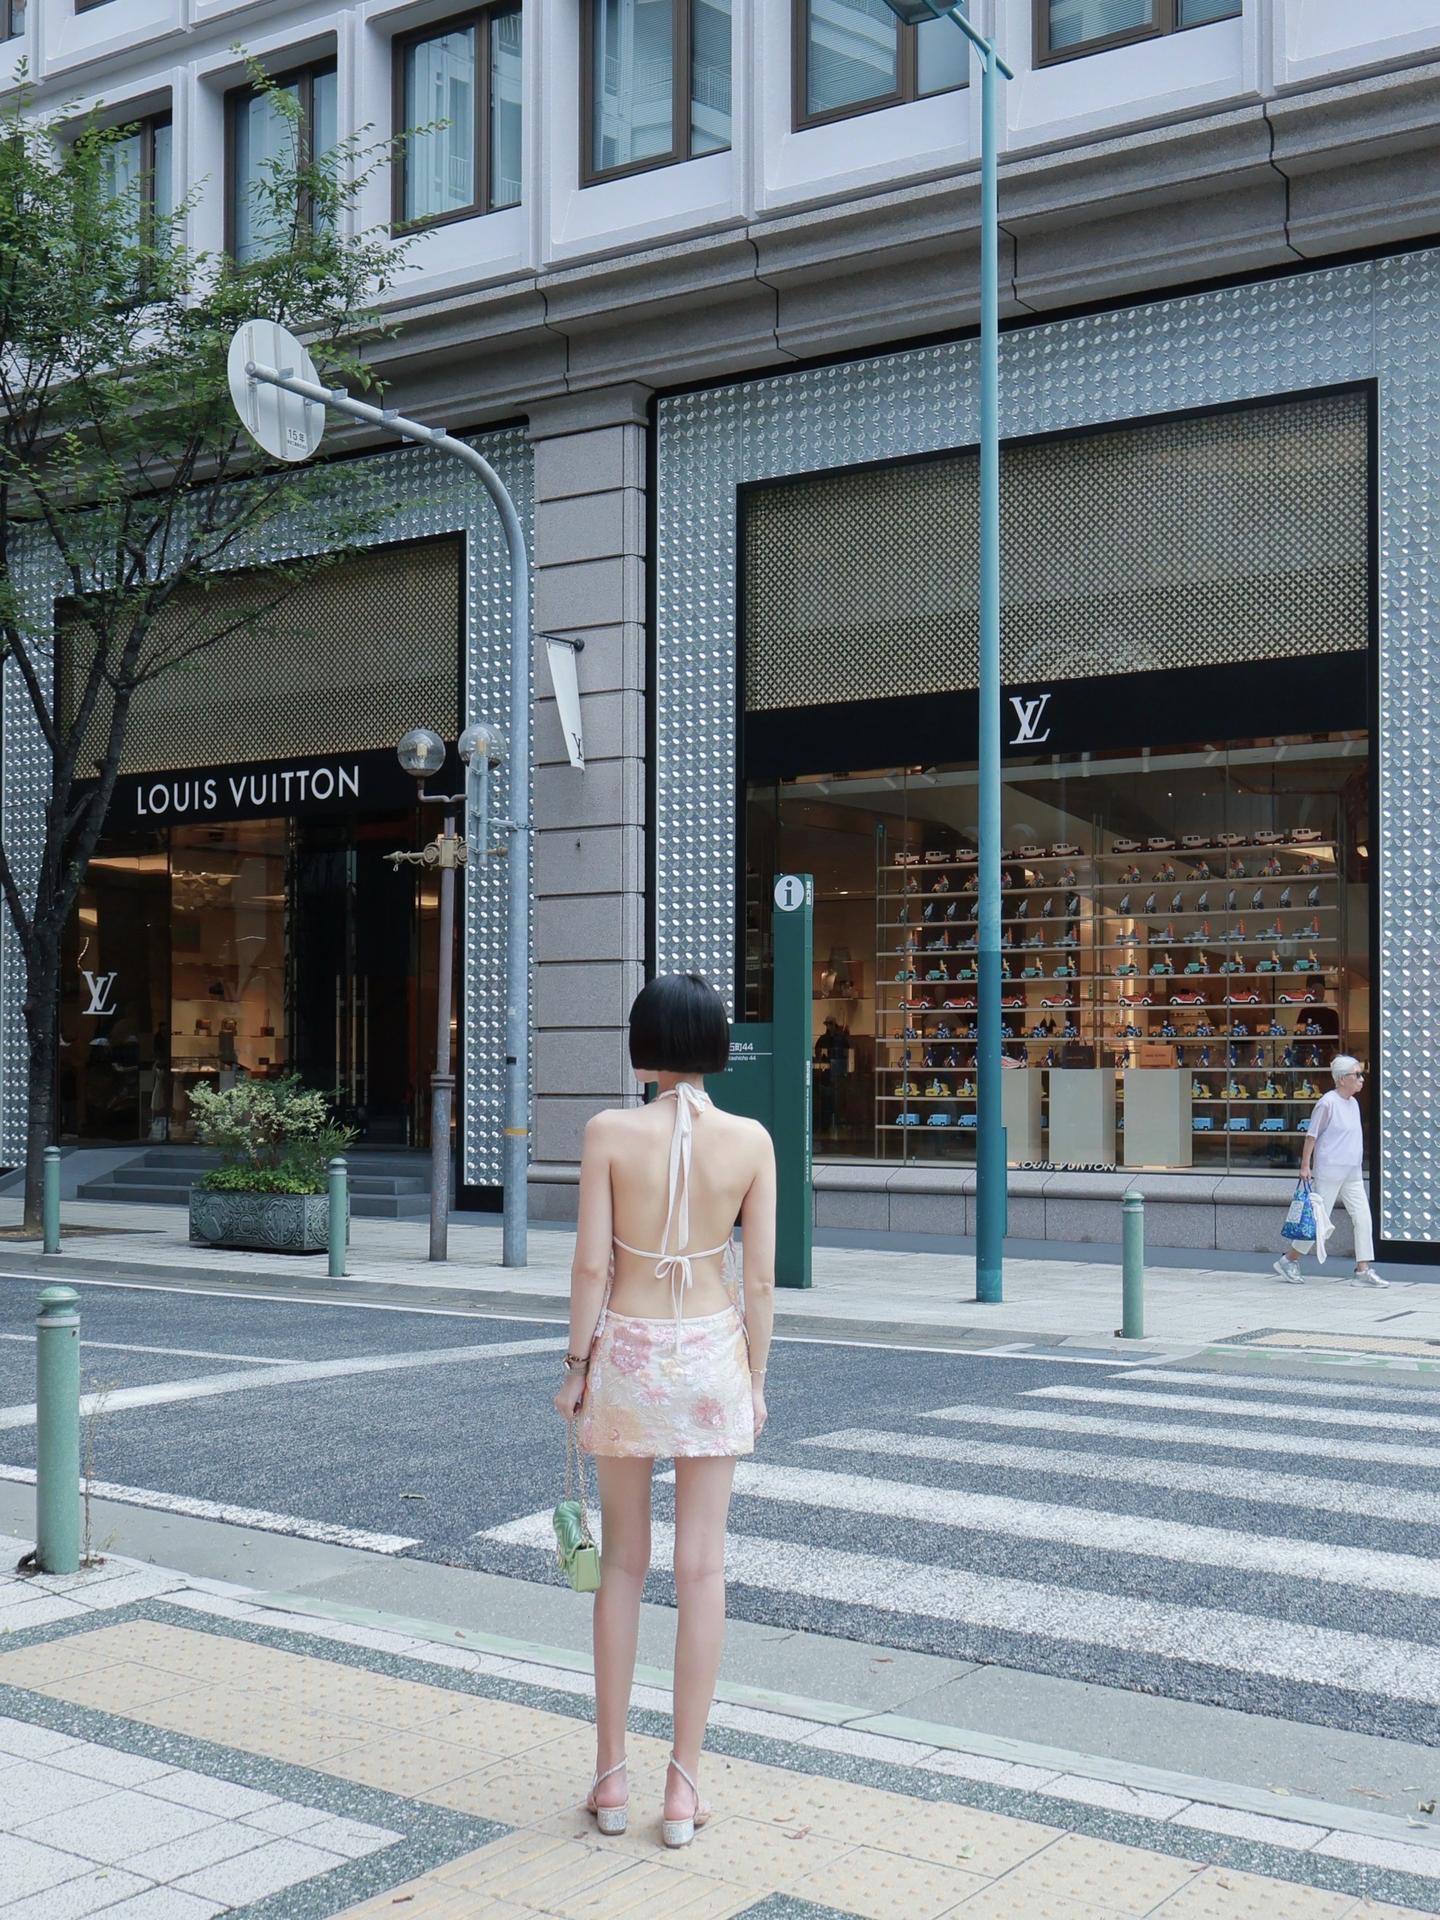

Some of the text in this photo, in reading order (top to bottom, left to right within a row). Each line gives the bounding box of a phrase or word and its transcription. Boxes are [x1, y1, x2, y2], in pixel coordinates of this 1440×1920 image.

[1009, 693, 1051, 744] LV
[137, 765, 359, 815] LOUIS VUITTON
[82, 970, 118, 1015] LV
